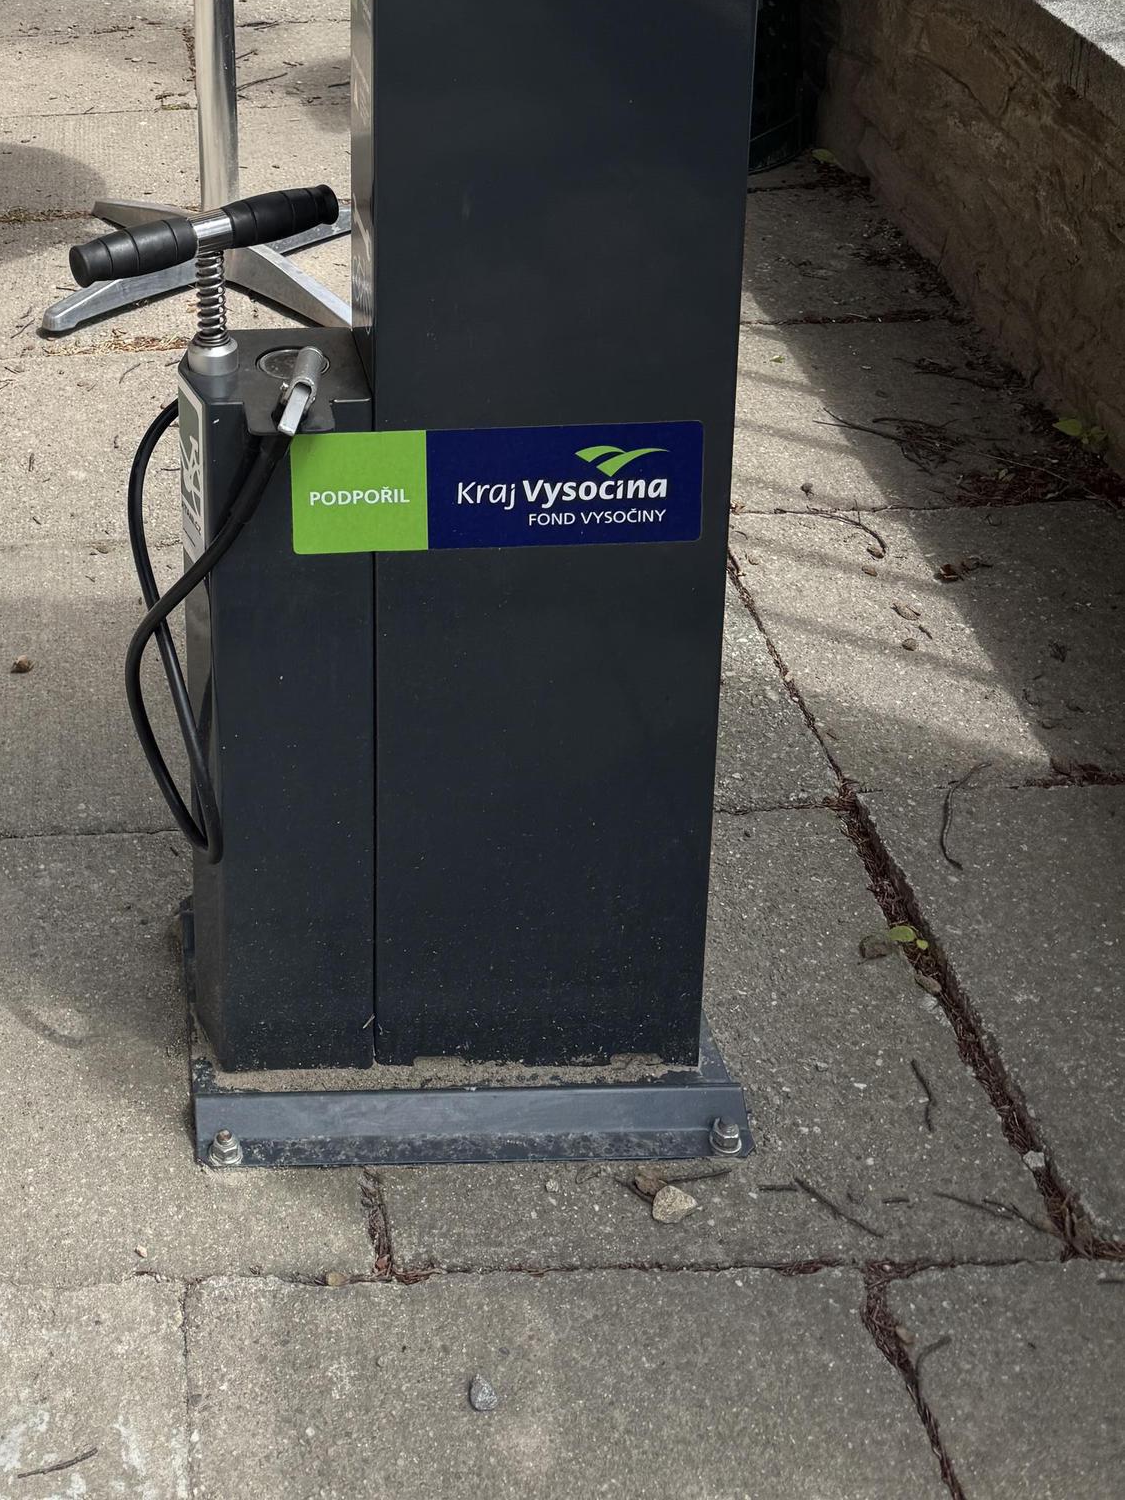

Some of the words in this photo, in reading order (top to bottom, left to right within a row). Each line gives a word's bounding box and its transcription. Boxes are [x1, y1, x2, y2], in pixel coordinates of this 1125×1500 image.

[309, 488, 411, 507] PODPOŘIL
[456, 481, 516, 511] Kraj
[528, 512, 576, 527] FOND
[580, 509, 667, 525] VYSOČINY
